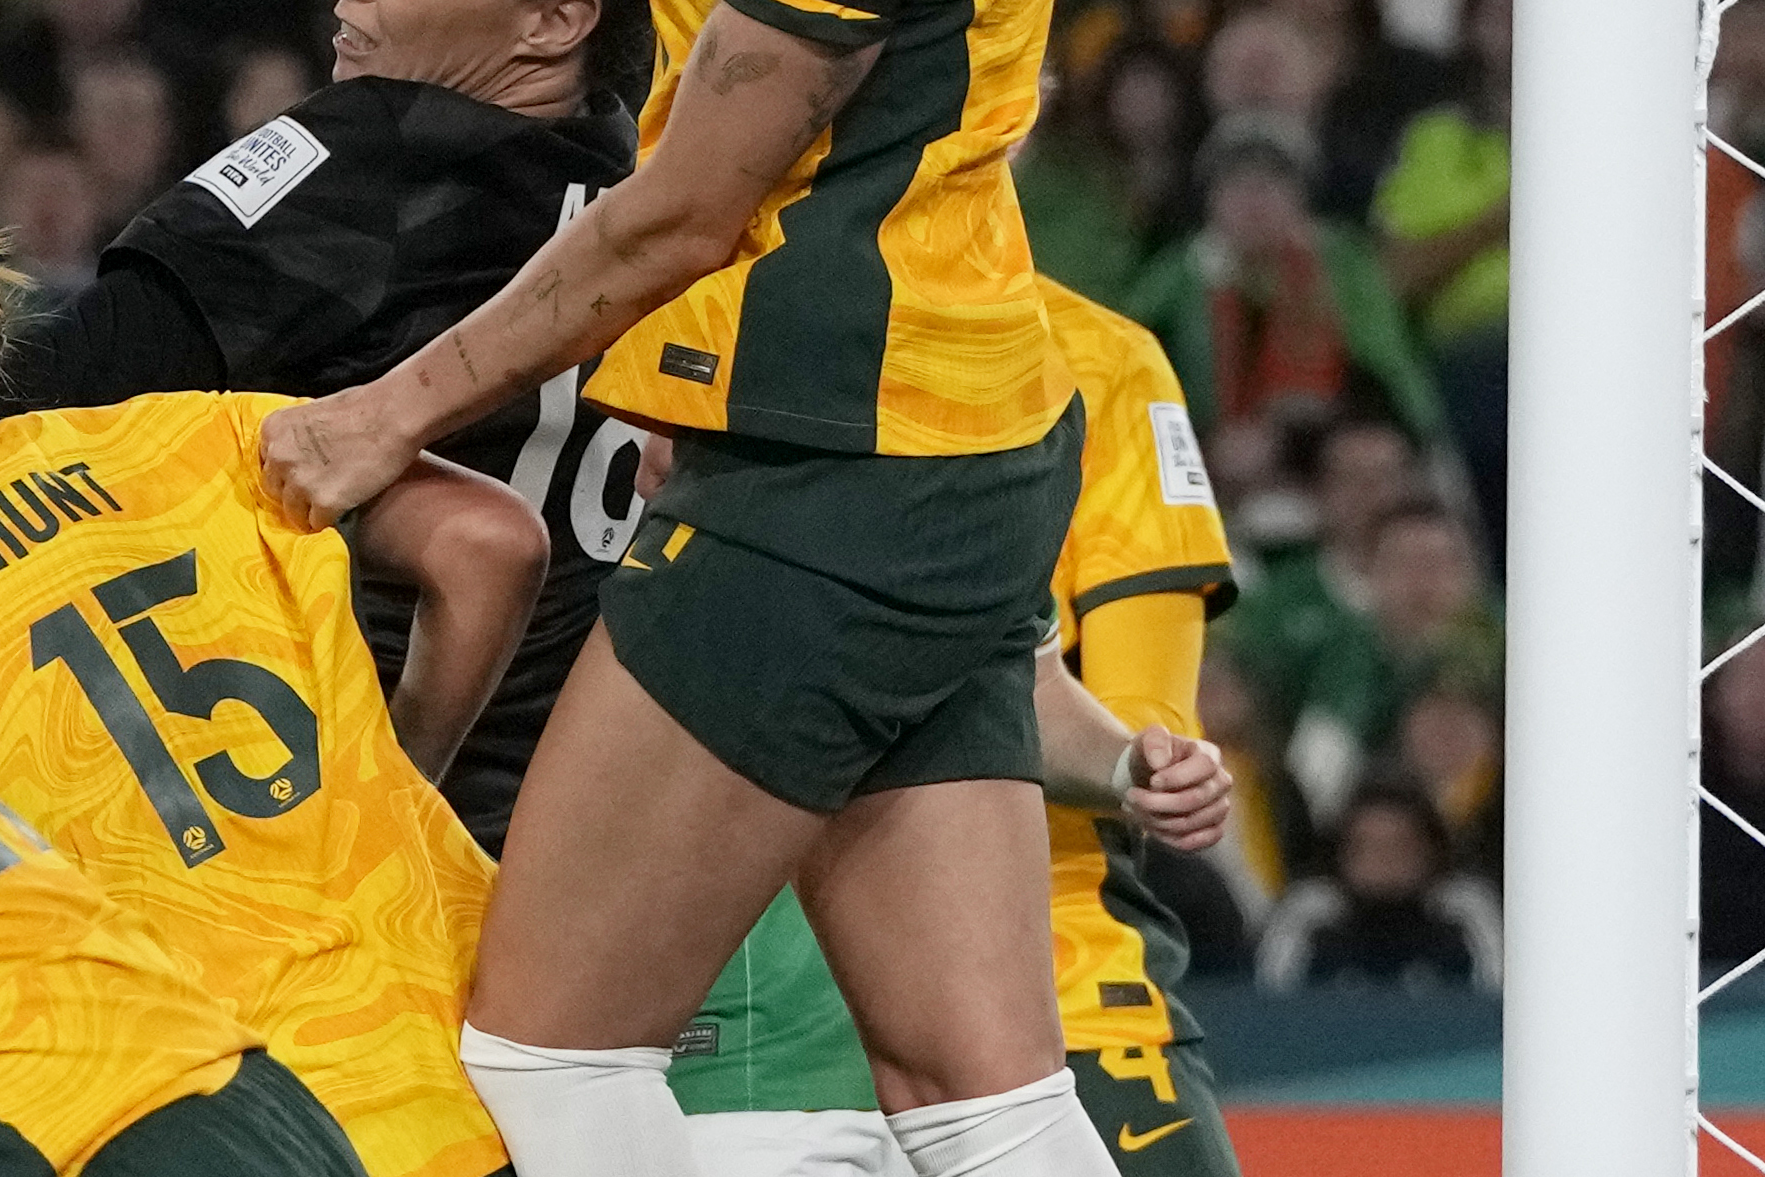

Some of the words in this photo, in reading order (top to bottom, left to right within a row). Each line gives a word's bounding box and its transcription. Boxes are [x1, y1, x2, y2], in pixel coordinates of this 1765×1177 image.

[238, 154, 277, 187] World
[240, 136, 288, 172] UNITES
[29, 547, 322, 869] 15
